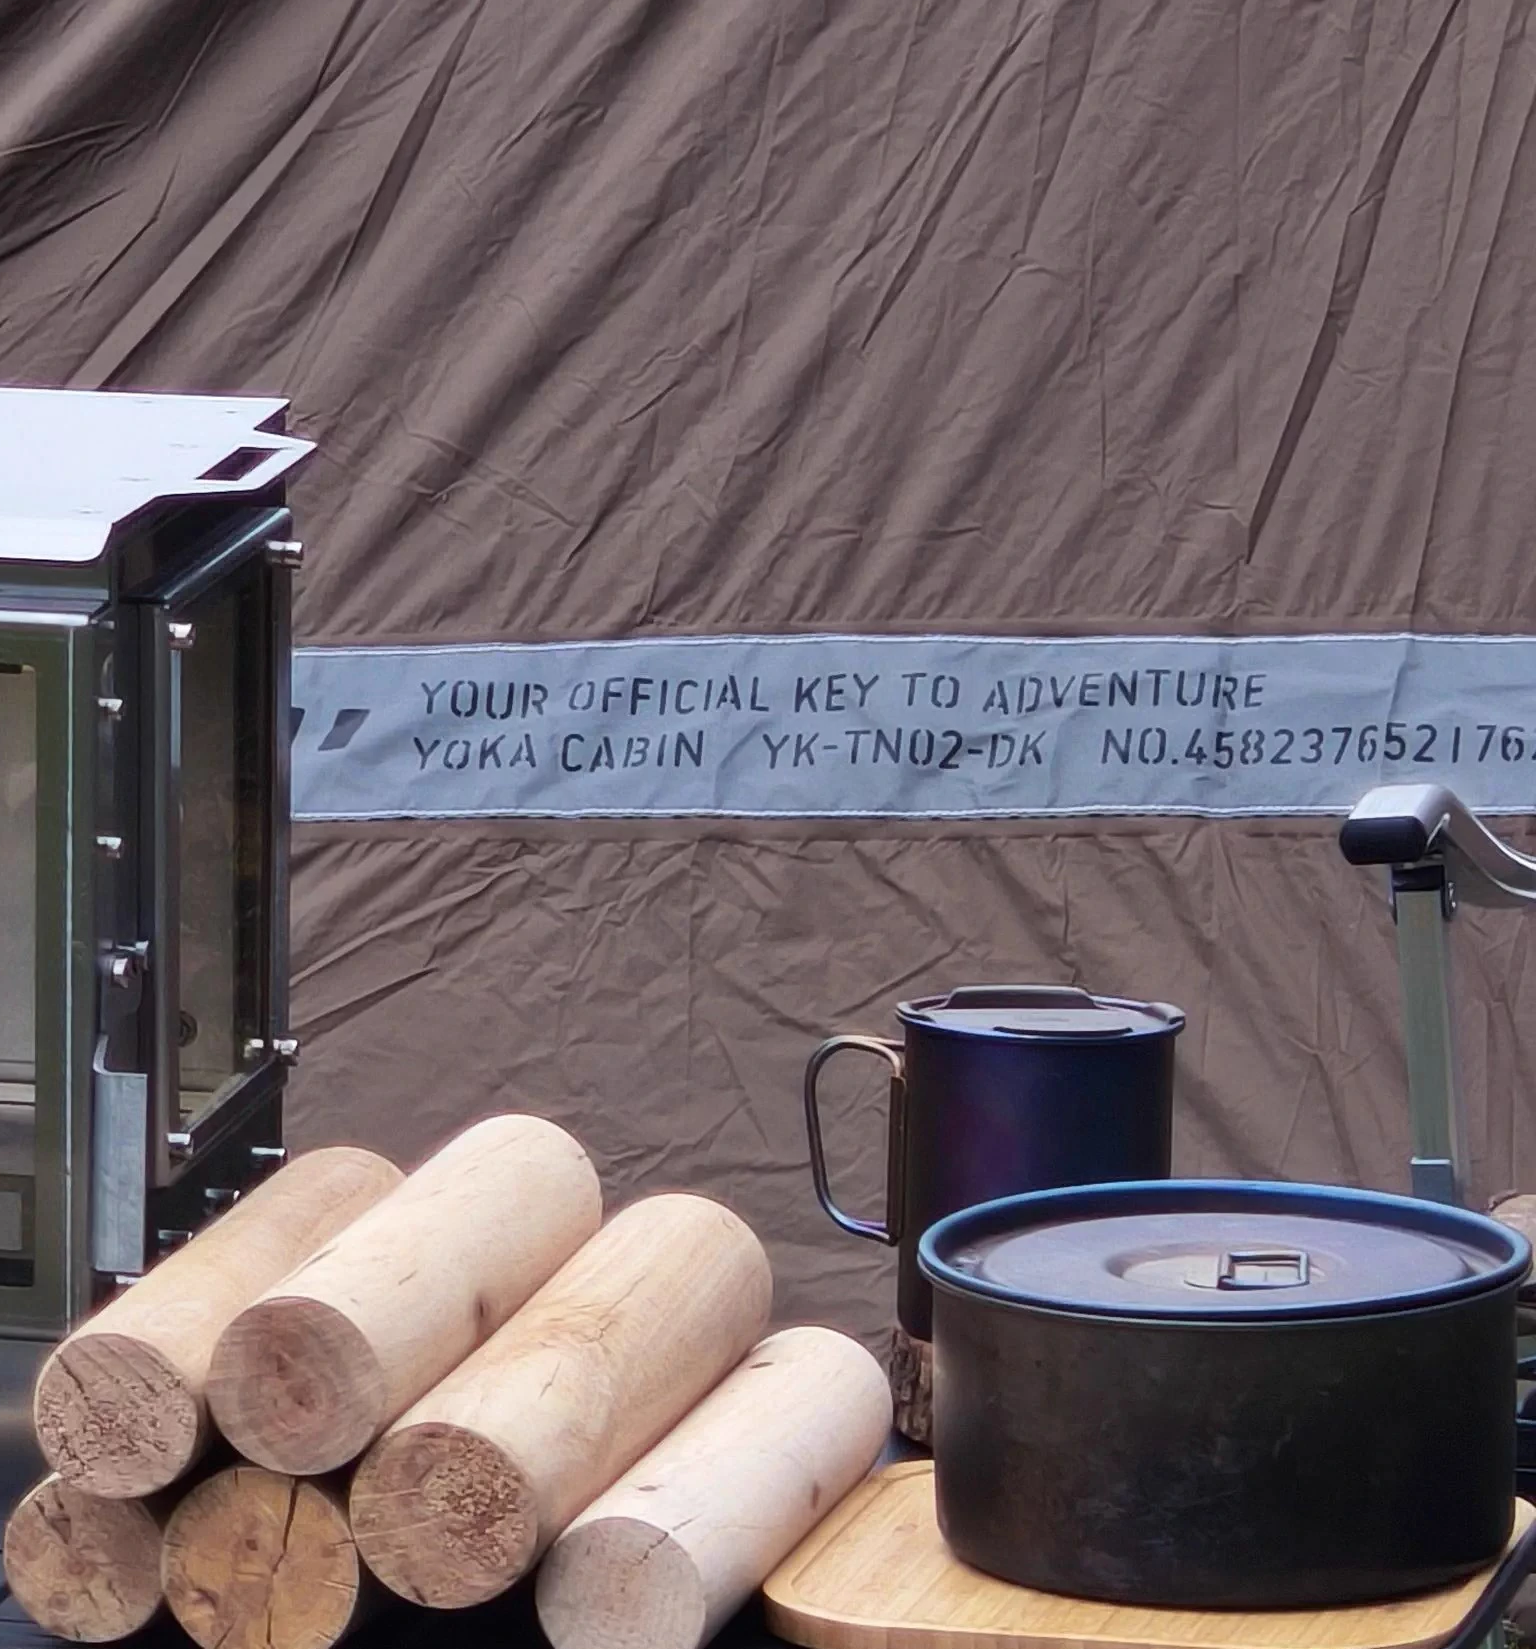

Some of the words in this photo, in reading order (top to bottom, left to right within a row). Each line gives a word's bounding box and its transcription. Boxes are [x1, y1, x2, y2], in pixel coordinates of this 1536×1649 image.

[421, 679, 549, 719] YOUR
[569, 675, 769, 715] OFFICIAL
[794, 673, 879, 713] KEY
[901, 672, 961, 710] TO
[982, 669, 1267, 714] ADVENTURE
[413, 734, 537, 771] YOKA
[561, 730, 704, 773] CABIN
[763, 728, 1046, 770] YK-TN02-DK
[1101, 723, 1536, 769] NO.458237652176
